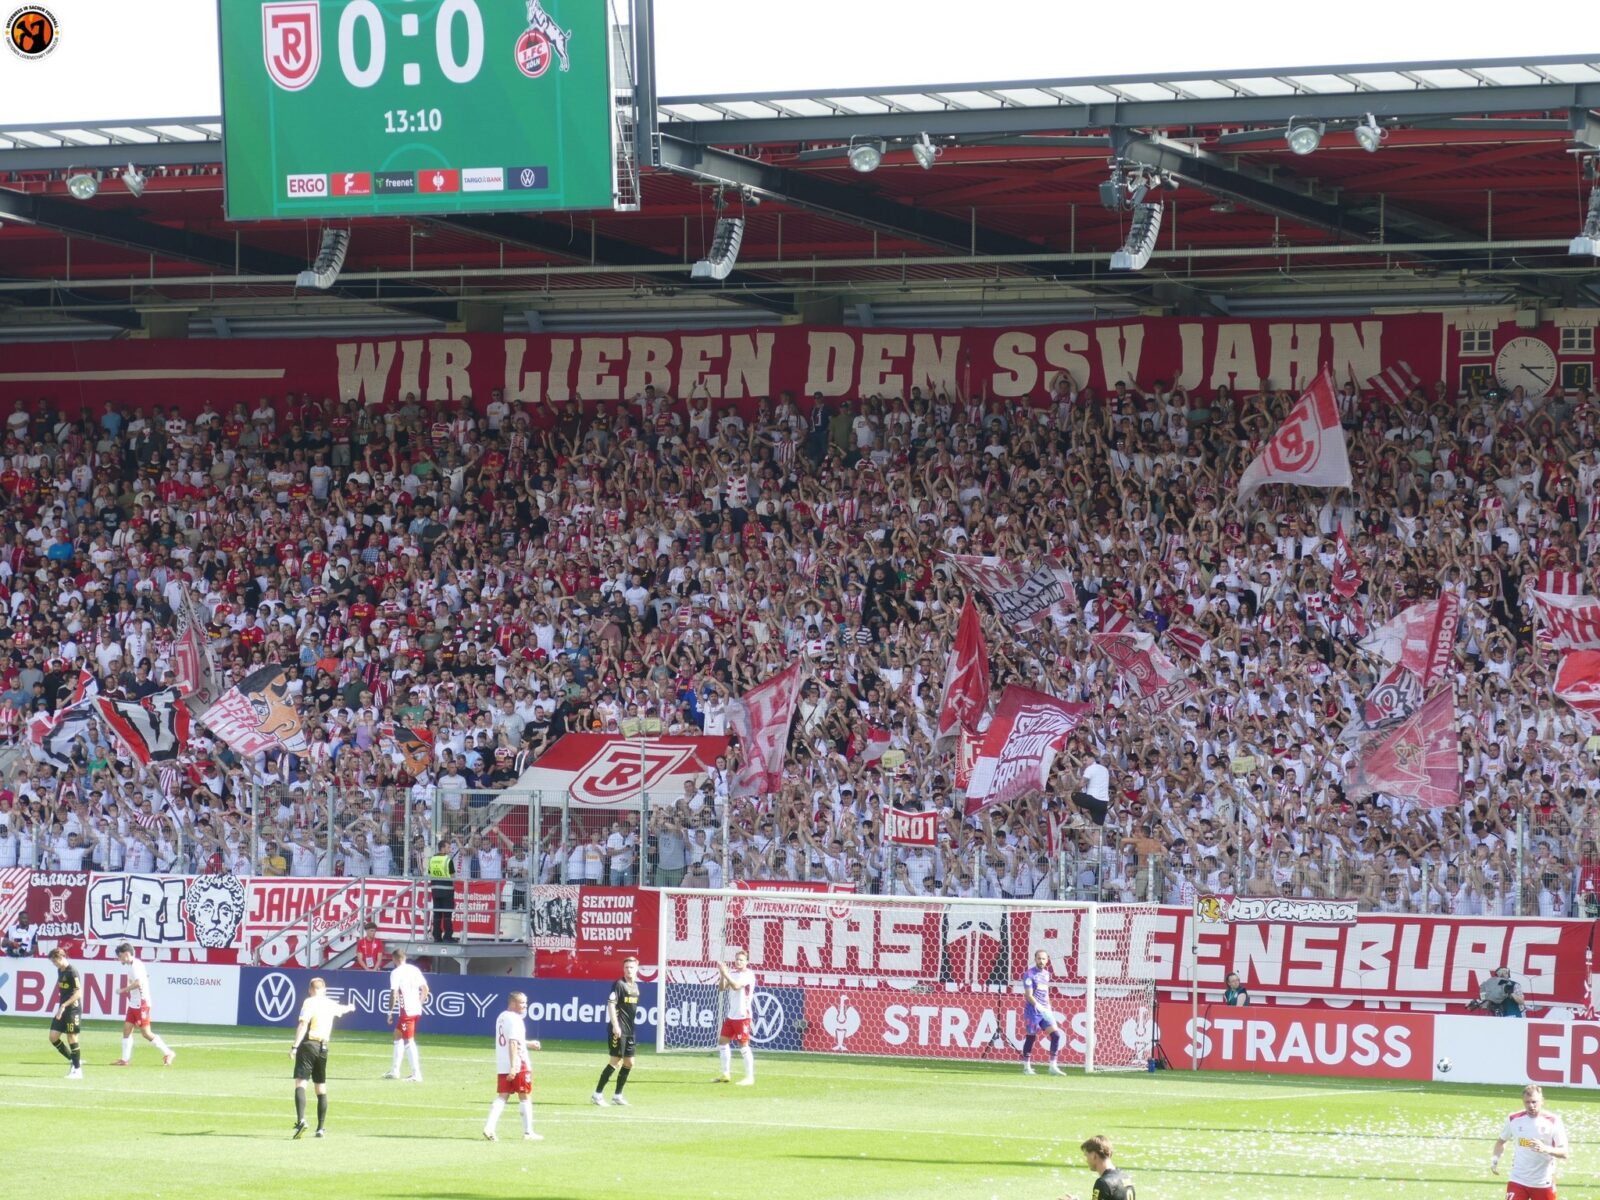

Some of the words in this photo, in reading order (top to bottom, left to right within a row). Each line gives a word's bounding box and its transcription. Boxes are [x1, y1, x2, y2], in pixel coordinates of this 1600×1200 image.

[383, 108, 443, 135] 13:10
[289, 177, 325, 194] ERGO
[385, 177, 414, 188] freenet
[336, 339, 474, 404] WIR
[504, 332, 775, 403] LIEBEN
[805, 330, 961, 401] DEN
[992, 324, 1145, 398] SSV
[1177, 320, 1384, 392] JAHN
[249, 887, 432, 927] JAHNGSTERS
[581, 895, 635, 909] SEKTION
[752, 902, 822, 915] INTERNATIONAL
[1228, 899, 1265, 921] RED
[1266, 899, 1358, 922] GENERATION
[581, 911, 633, 925] STADION
[581, 927, 633, 942] VERBOT
[665, 894, 924, 972] ULTRAS
[1028, 909, 1562, 996] REGENSBURG
[883, 1004, 1097, 1053] STRAUSS
[1183, 1016, 1413, 1069] STRAUSS
